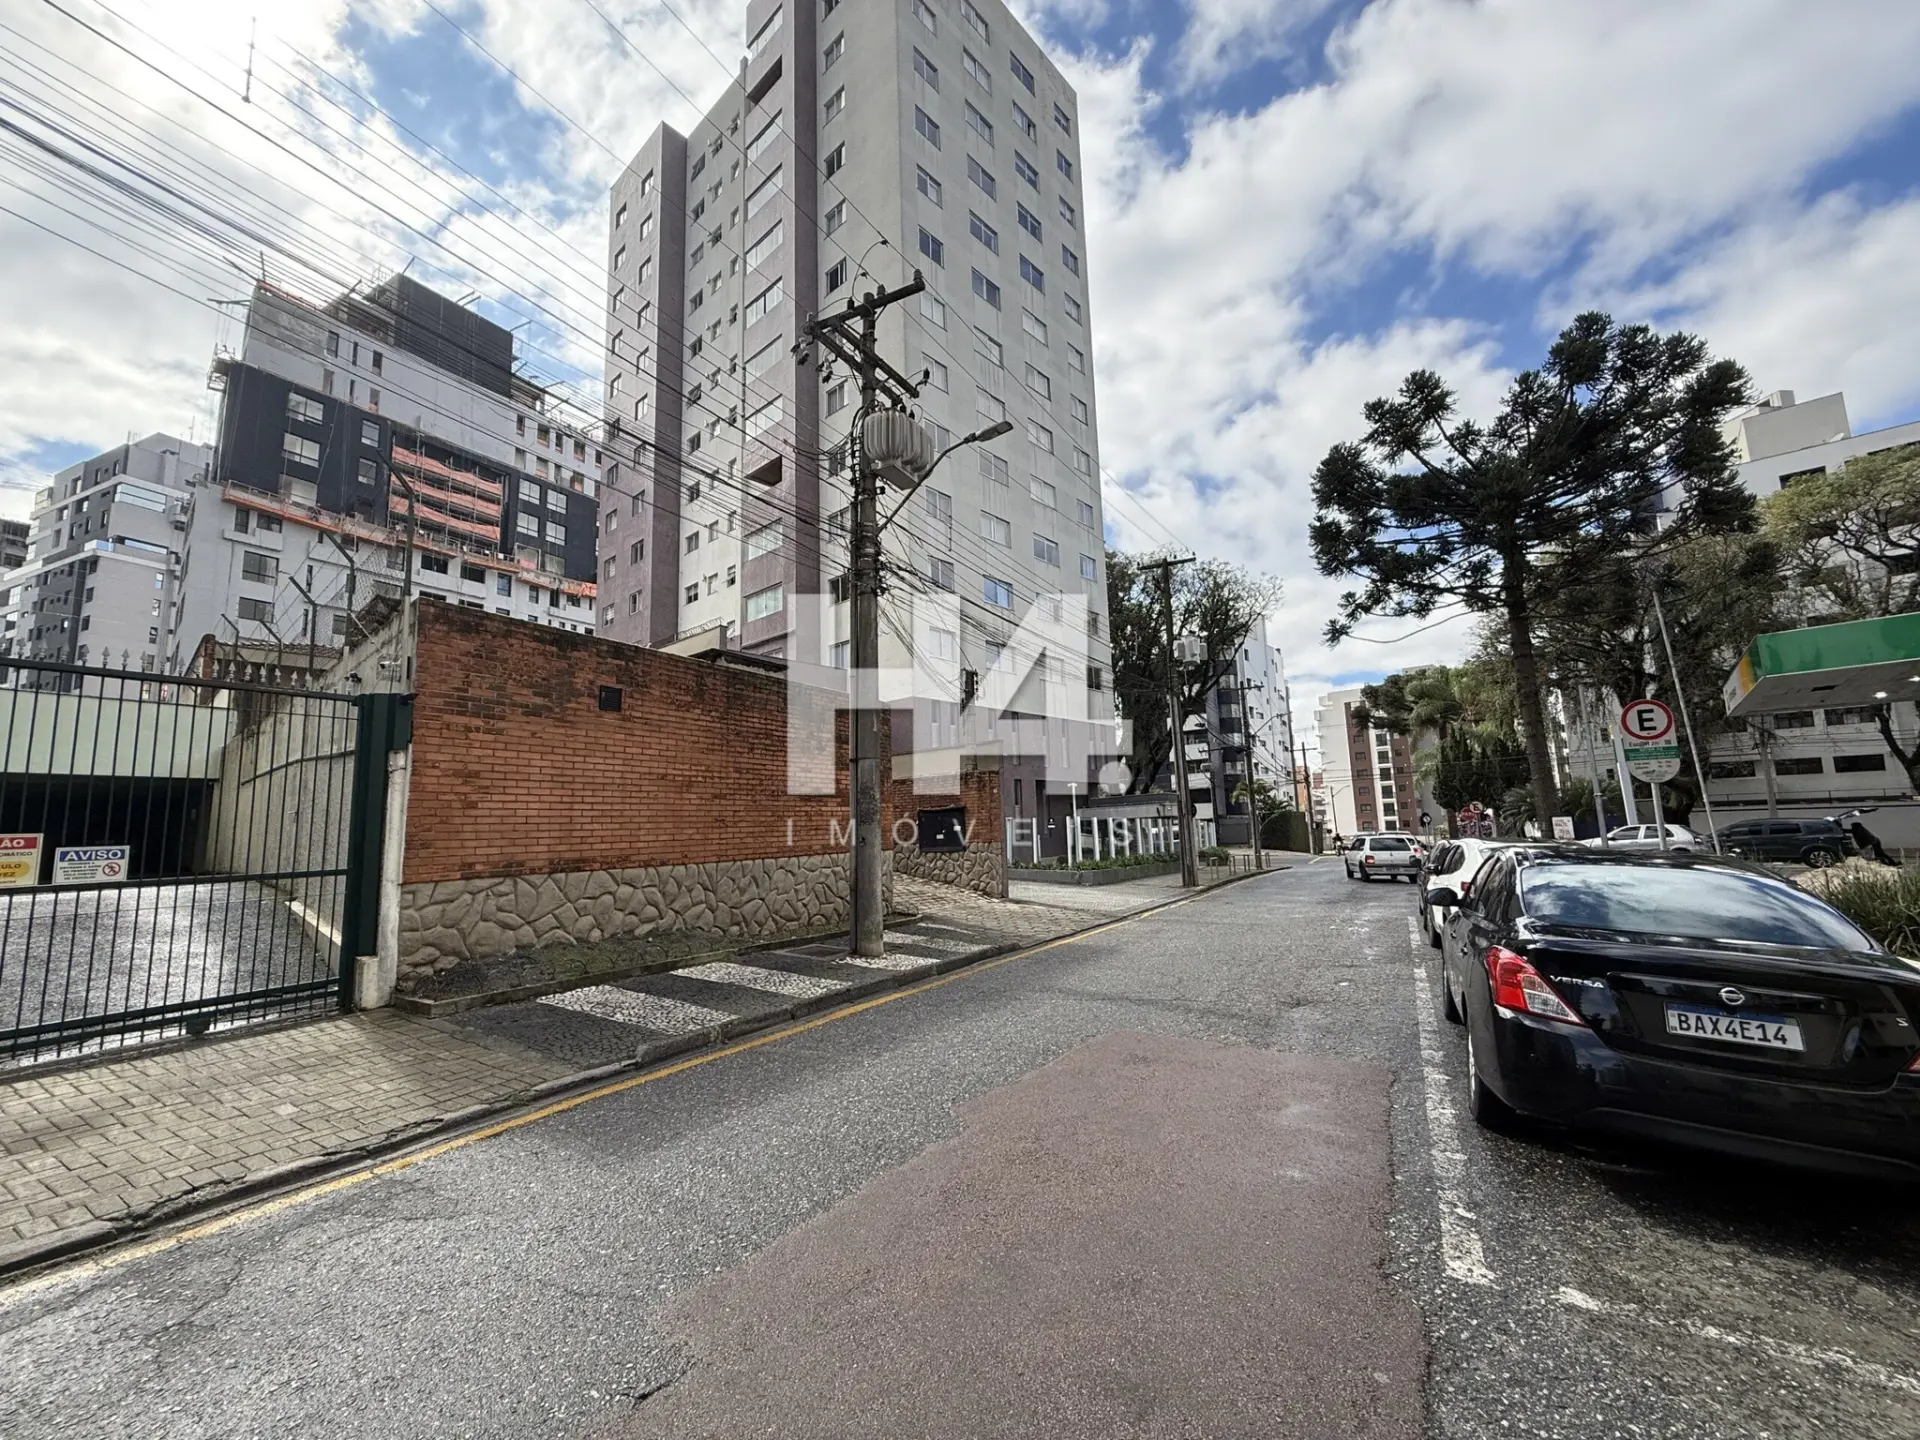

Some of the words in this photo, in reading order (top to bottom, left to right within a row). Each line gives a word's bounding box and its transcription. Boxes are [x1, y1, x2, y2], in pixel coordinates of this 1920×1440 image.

[1637, 709, 1657, 731] E
[64, 849, 122, 861] AVISO
[1677, 1013, 1788, 1045] BAX4E14
